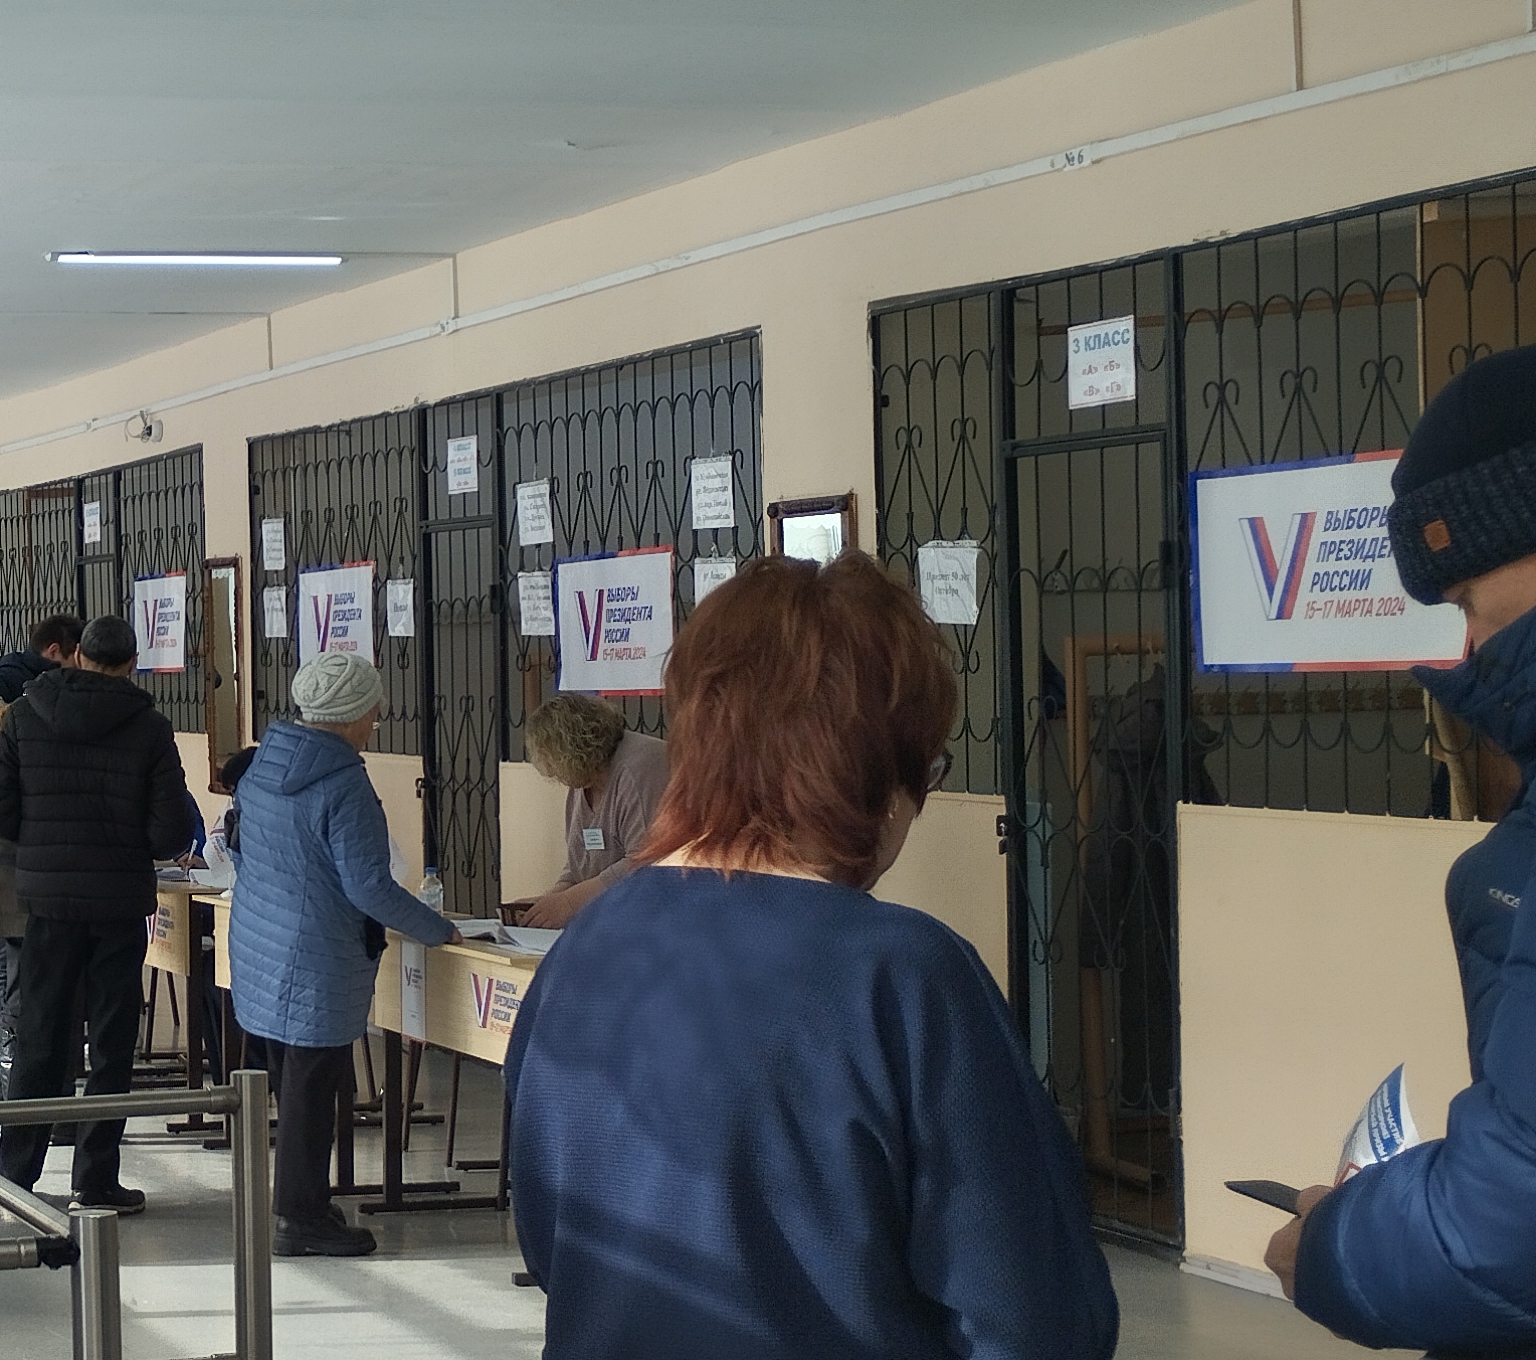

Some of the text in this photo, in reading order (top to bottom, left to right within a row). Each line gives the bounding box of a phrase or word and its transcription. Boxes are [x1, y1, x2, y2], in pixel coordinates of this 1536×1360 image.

[1072, 328, 1131, 354] 3 КЛАСС
[1316, 536, 1395, 562] ПРЕЗИДЕ
[1309, 568, 1373, 593] РОССИИ
[606, 586, 640, 603] ВЫБОРЫ
[605, 605, 653, 624] ПРЕЗИДЕНТА
[1334, 597, 1374, 619] МАРТА
[1375, 595, 1406, 617] 2024
